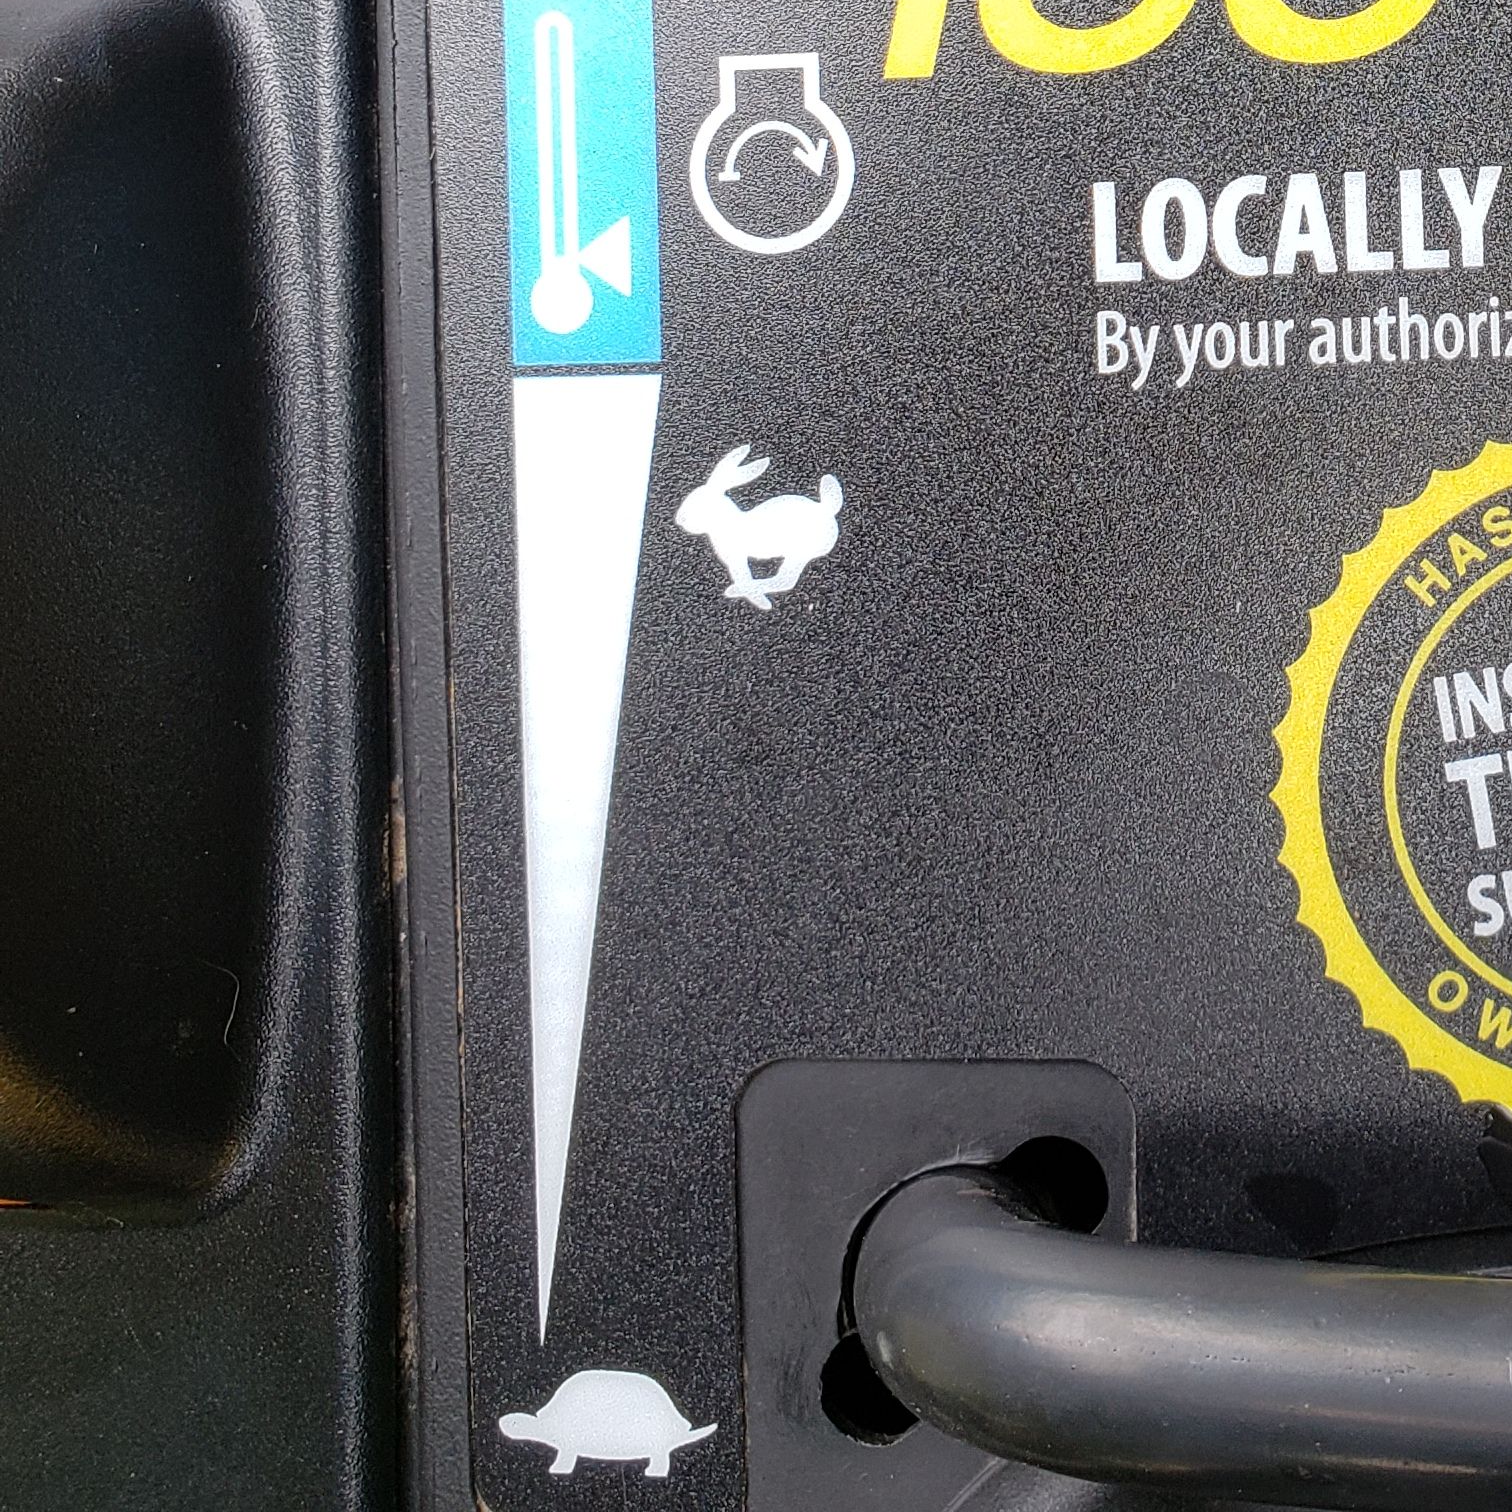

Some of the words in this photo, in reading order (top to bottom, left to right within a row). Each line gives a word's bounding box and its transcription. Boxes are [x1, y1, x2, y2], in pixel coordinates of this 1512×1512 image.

[1093, 166, 1503, 283] LOCALLY
[1096, 310, 1161, 388] By
[1175, 317, 1295, 387] your
